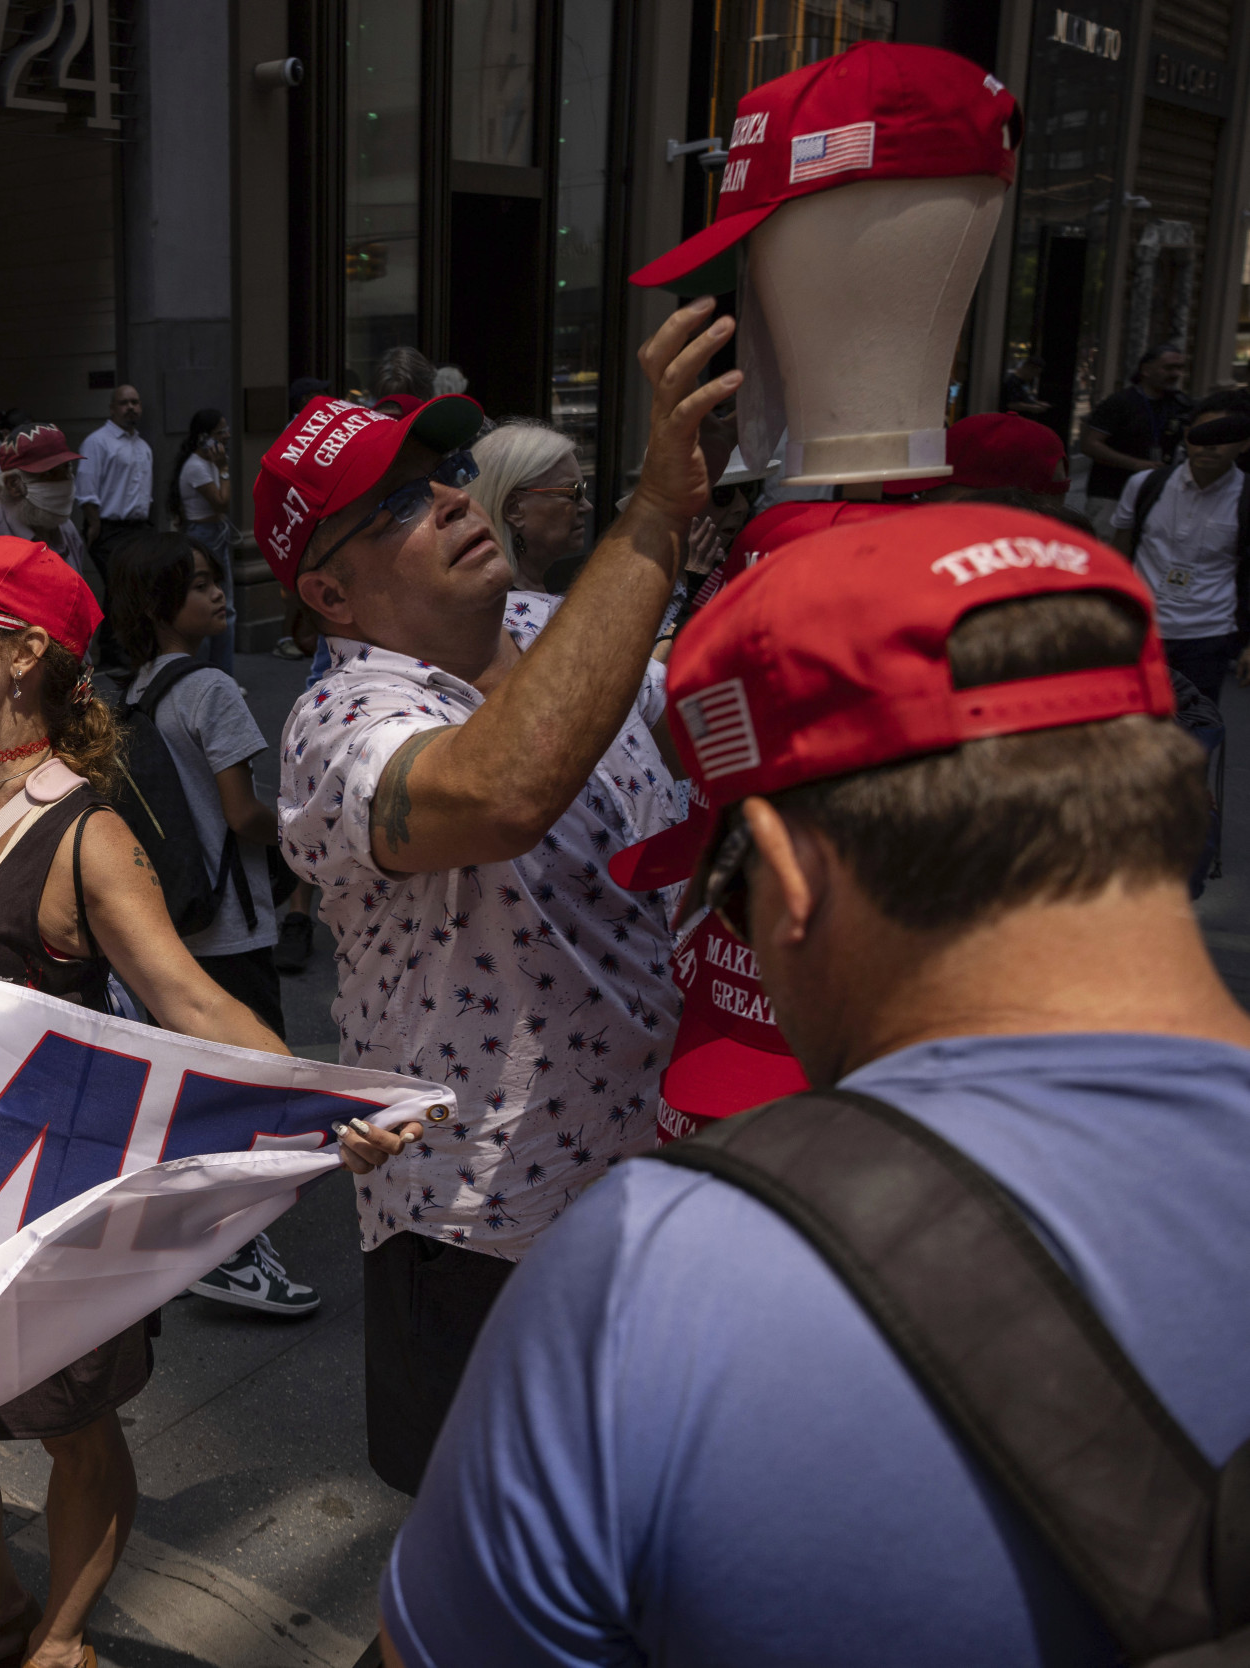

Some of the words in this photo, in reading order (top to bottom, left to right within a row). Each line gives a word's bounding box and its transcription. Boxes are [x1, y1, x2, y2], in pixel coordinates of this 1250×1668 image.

[280, 410, 334, 466] MAKE
[313, 413, 371, 467] GREAT
[268, 486, 310, 561] 45-47
[930, 536, 1090, 587] TRUMP
[705, 933, 763, 981] MAKE
